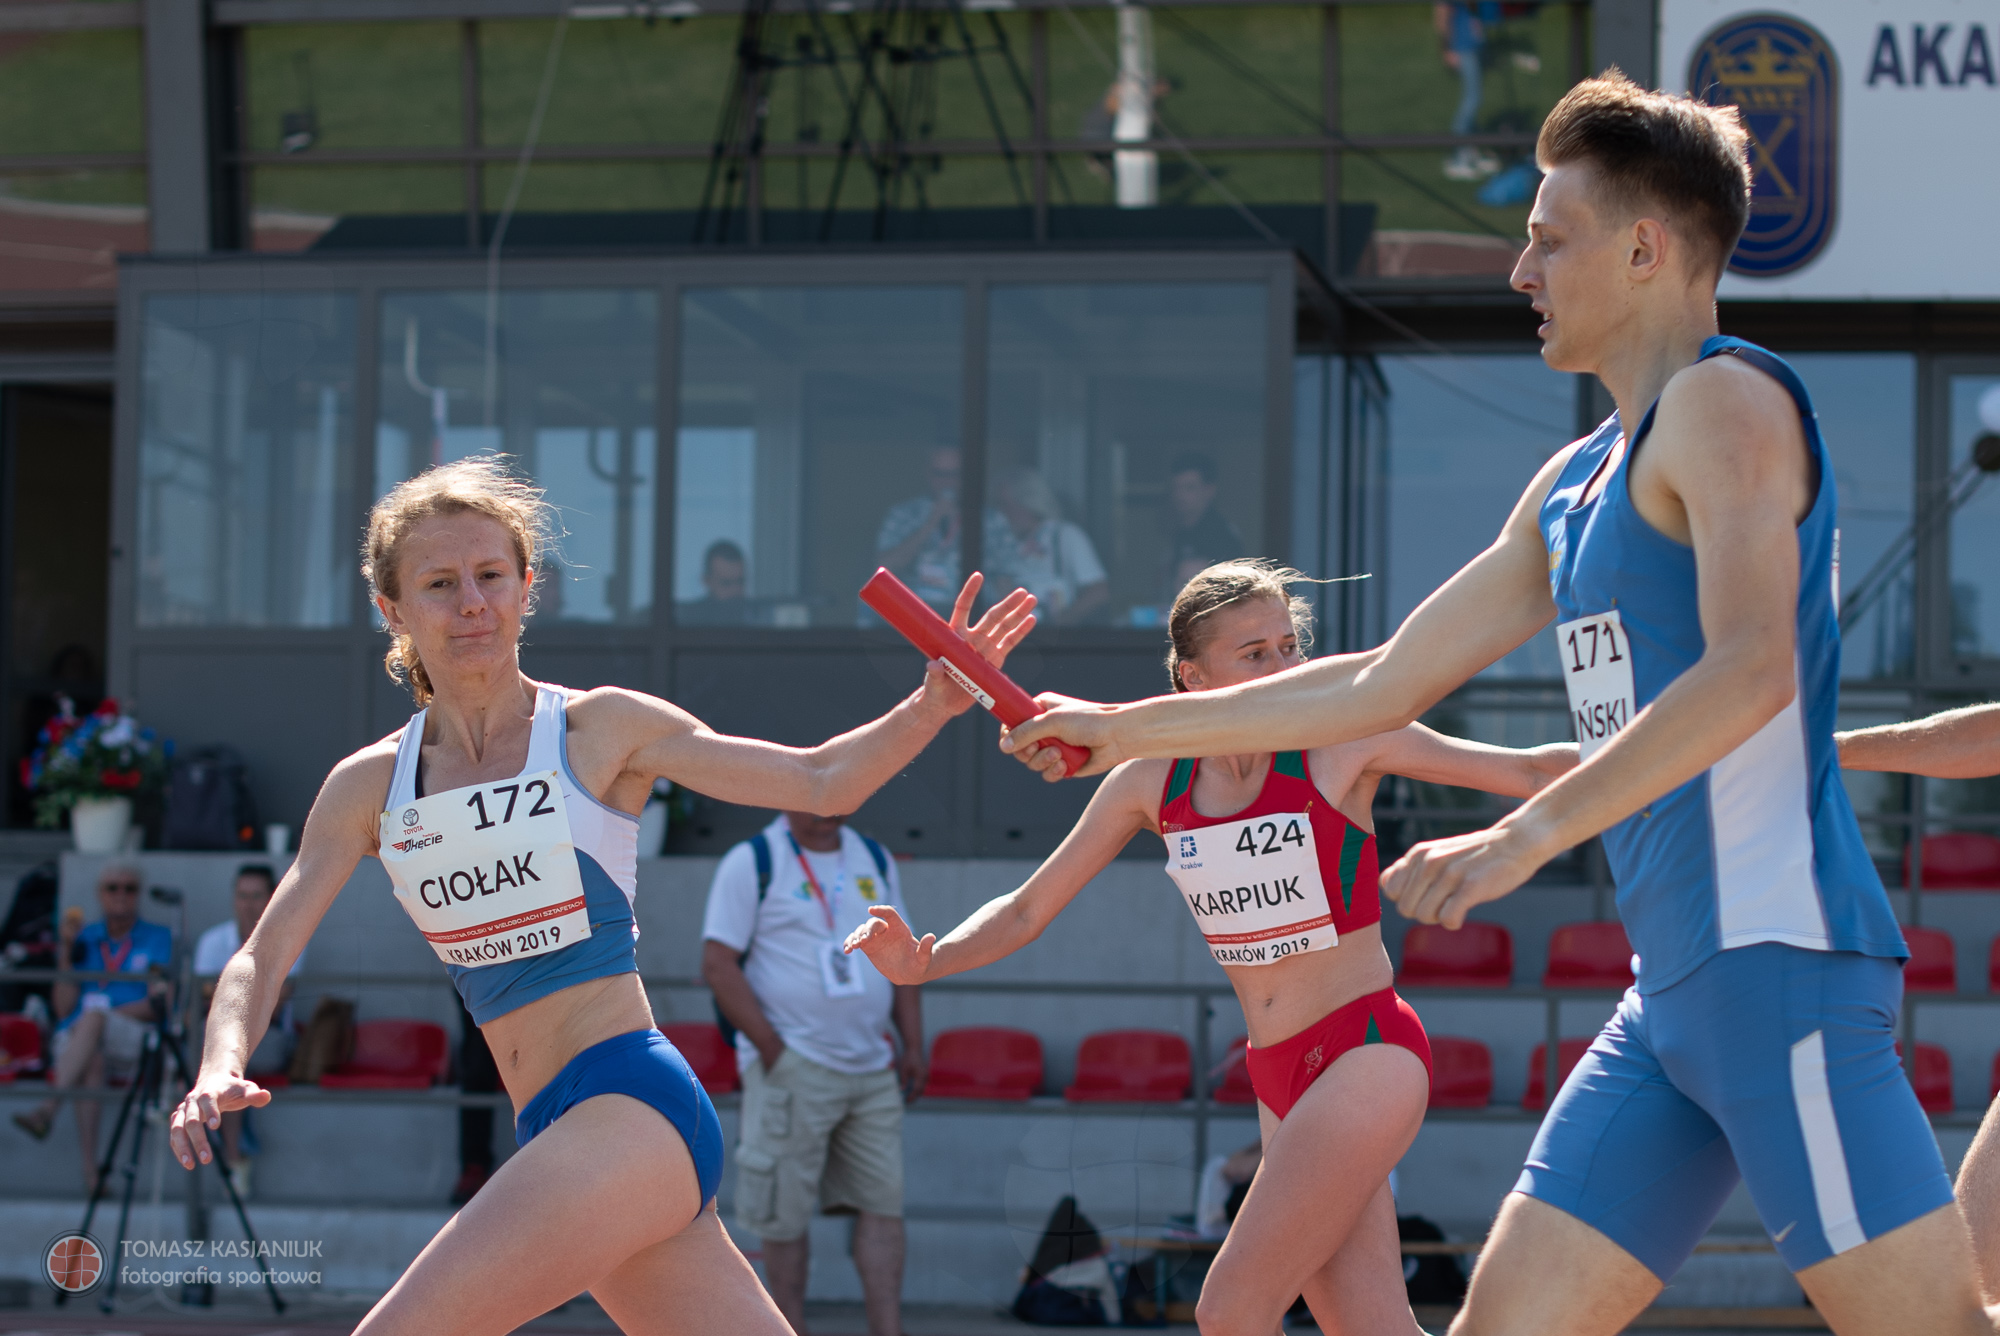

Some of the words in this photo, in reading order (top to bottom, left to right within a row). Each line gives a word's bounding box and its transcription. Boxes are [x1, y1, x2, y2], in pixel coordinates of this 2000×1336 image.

[1568, 621, 1623, 673] 171
[1573, 698, 1627, 743] ŃSKI
[466, 779, 556, 831] 172
[403, 825, 424, 835] TOYOTA
[1235, 819, 1306, 857] 424
[419, 851, 541, 909] CIOŁAK
[1180, 861, 1203, 870] Kraków
[543, 900, 583, 917] SZTAFETACH
[1189, 875, 1305, 917] KARPIUK
[446, 938, 512, 963] KRAKÓW
[517, 926, 561, 952] 2019
[1213, 945, 1265, 962] KRAKÓW
[1271, 937, 1309, 959] 2019
